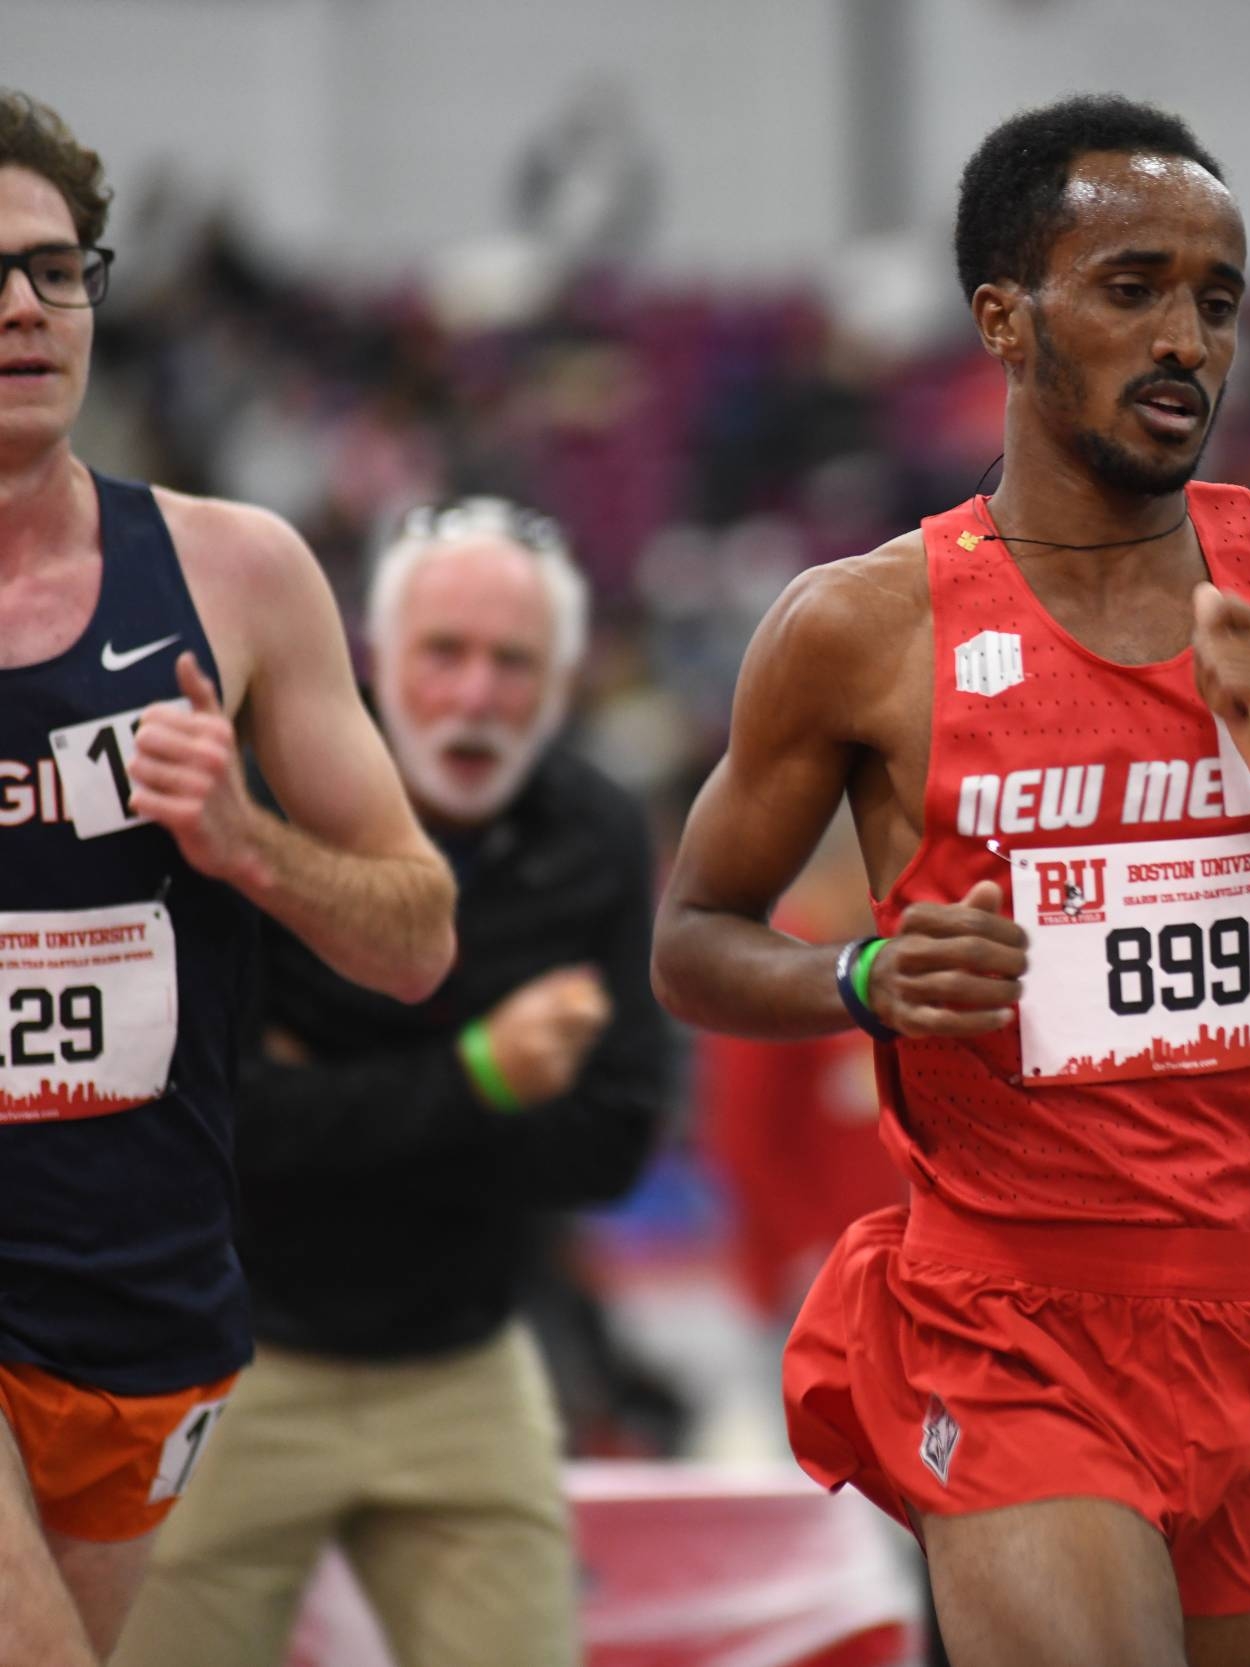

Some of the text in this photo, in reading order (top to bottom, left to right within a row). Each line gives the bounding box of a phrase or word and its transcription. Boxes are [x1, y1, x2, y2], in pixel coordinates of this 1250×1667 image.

[0, 758, 72, 826] GI
[86, 717, 141, 821] 1
[957, 757, 1223, 836] NEW ME
[1035, 858, 1107, 913] BU
[1127, 860, 1195, 883] BOSTON
[0, 923, 146, 949] STON UNIVERSITY
[1106, 916, 1250, 1016] 899
[0, 983, 104, 1067] 29
